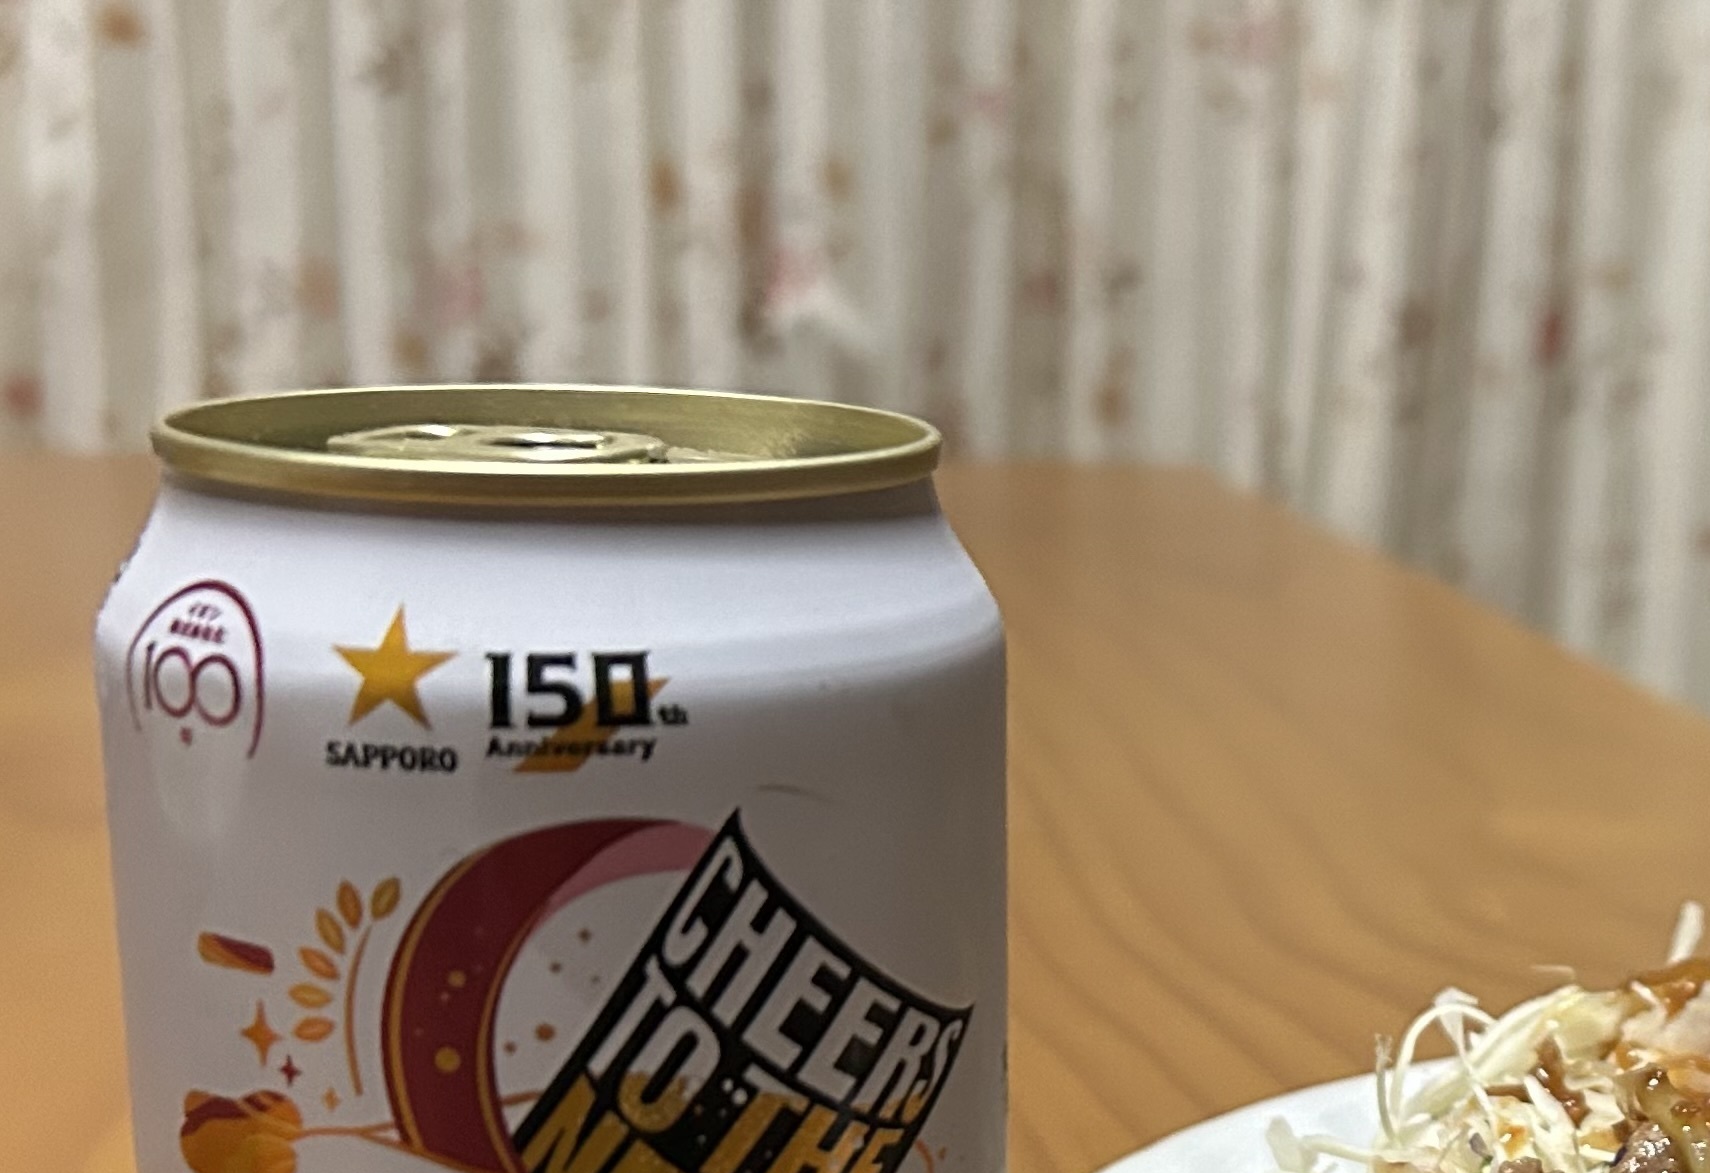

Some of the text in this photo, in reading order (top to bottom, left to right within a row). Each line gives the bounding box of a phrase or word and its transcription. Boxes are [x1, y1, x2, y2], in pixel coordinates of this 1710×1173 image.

[326, 740, 458, 774] SAPPORO
[485, 735, 657, 765] Anniversary
[661, 833, 964, 1120] CHEERS
[588, 955, 722, 1134] TO
